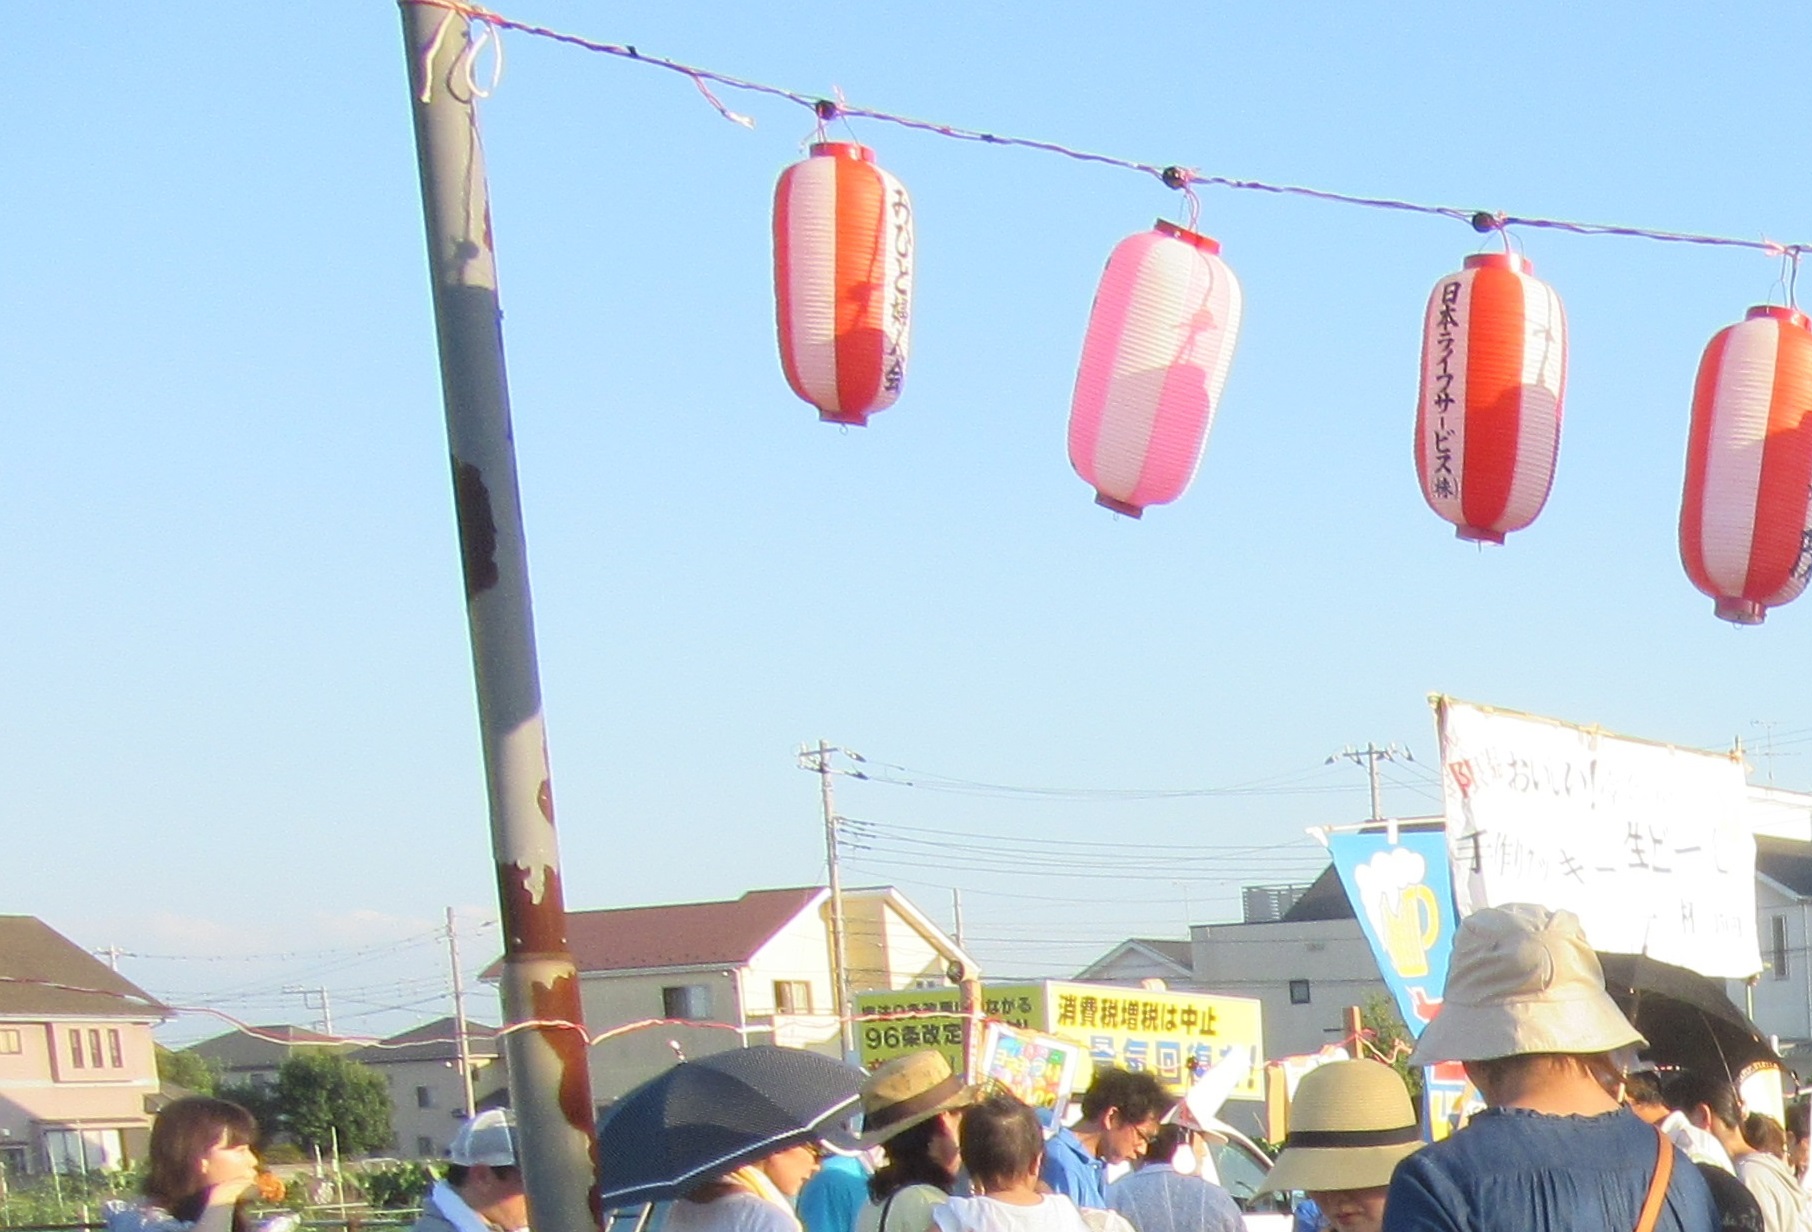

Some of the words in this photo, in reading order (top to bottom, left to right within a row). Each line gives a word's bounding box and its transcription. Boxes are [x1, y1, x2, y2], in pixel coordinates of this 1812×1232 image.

[1058, 993, 1219, 1037] 消費税増税は中止
